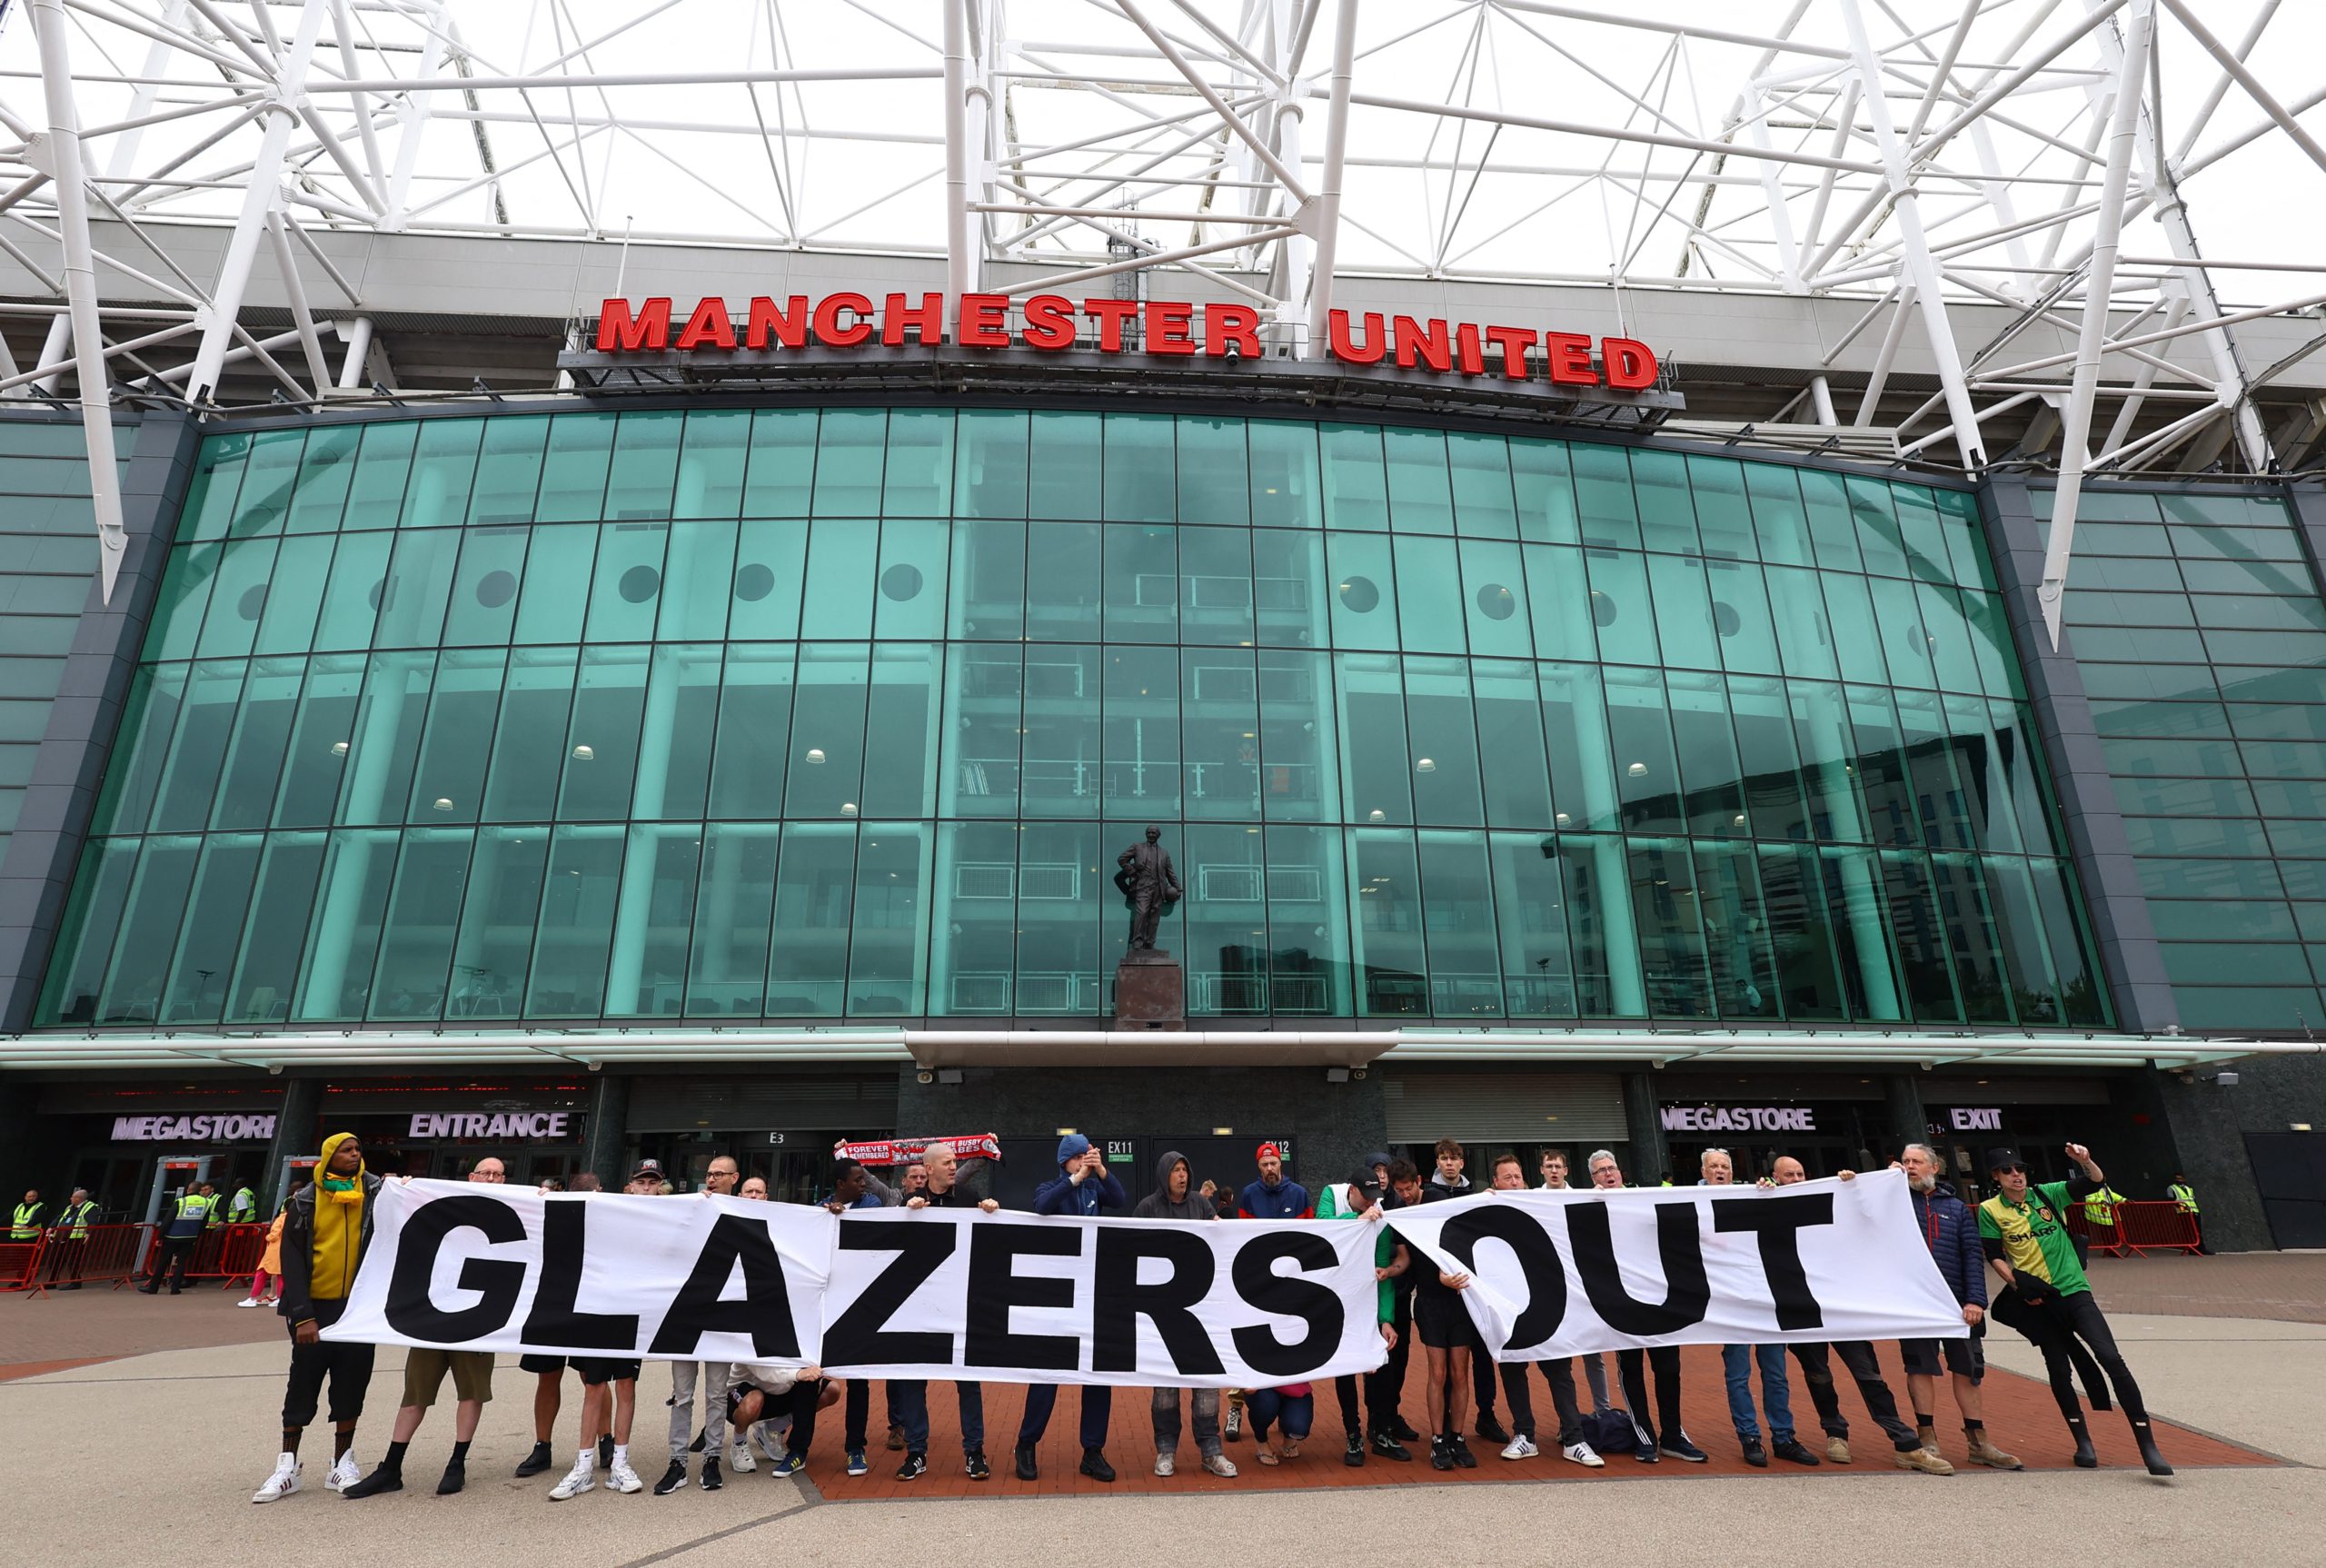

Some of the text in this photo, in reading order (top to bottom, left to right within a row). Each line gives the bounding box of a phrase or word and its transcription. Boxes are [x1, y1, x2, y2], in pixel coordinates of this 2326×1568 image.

[596, 292, 1658, 392] MANCHESTER UNITED
[408, 1113, 569, 1137] ENTRANCE
[1660, 1107, 1816, 1131] MEGASTORE
[1950, 1108, 2002, 1129] EXIT
[769, 1131, 784, 1144] E3
[958, 1138, 982, 1147] BUSBY
[848, 1145, 889, 1154] FOREVER
[951, 1145, 980, 1154] ABES
[1108, 1141, 1132, 1154] EX11
[1265, 1140, 1289, 1153] 12
[2009, 1226, 2057, 1243] SHARP
[384, 1193, 1834, 1376] GLAZERS OUT
